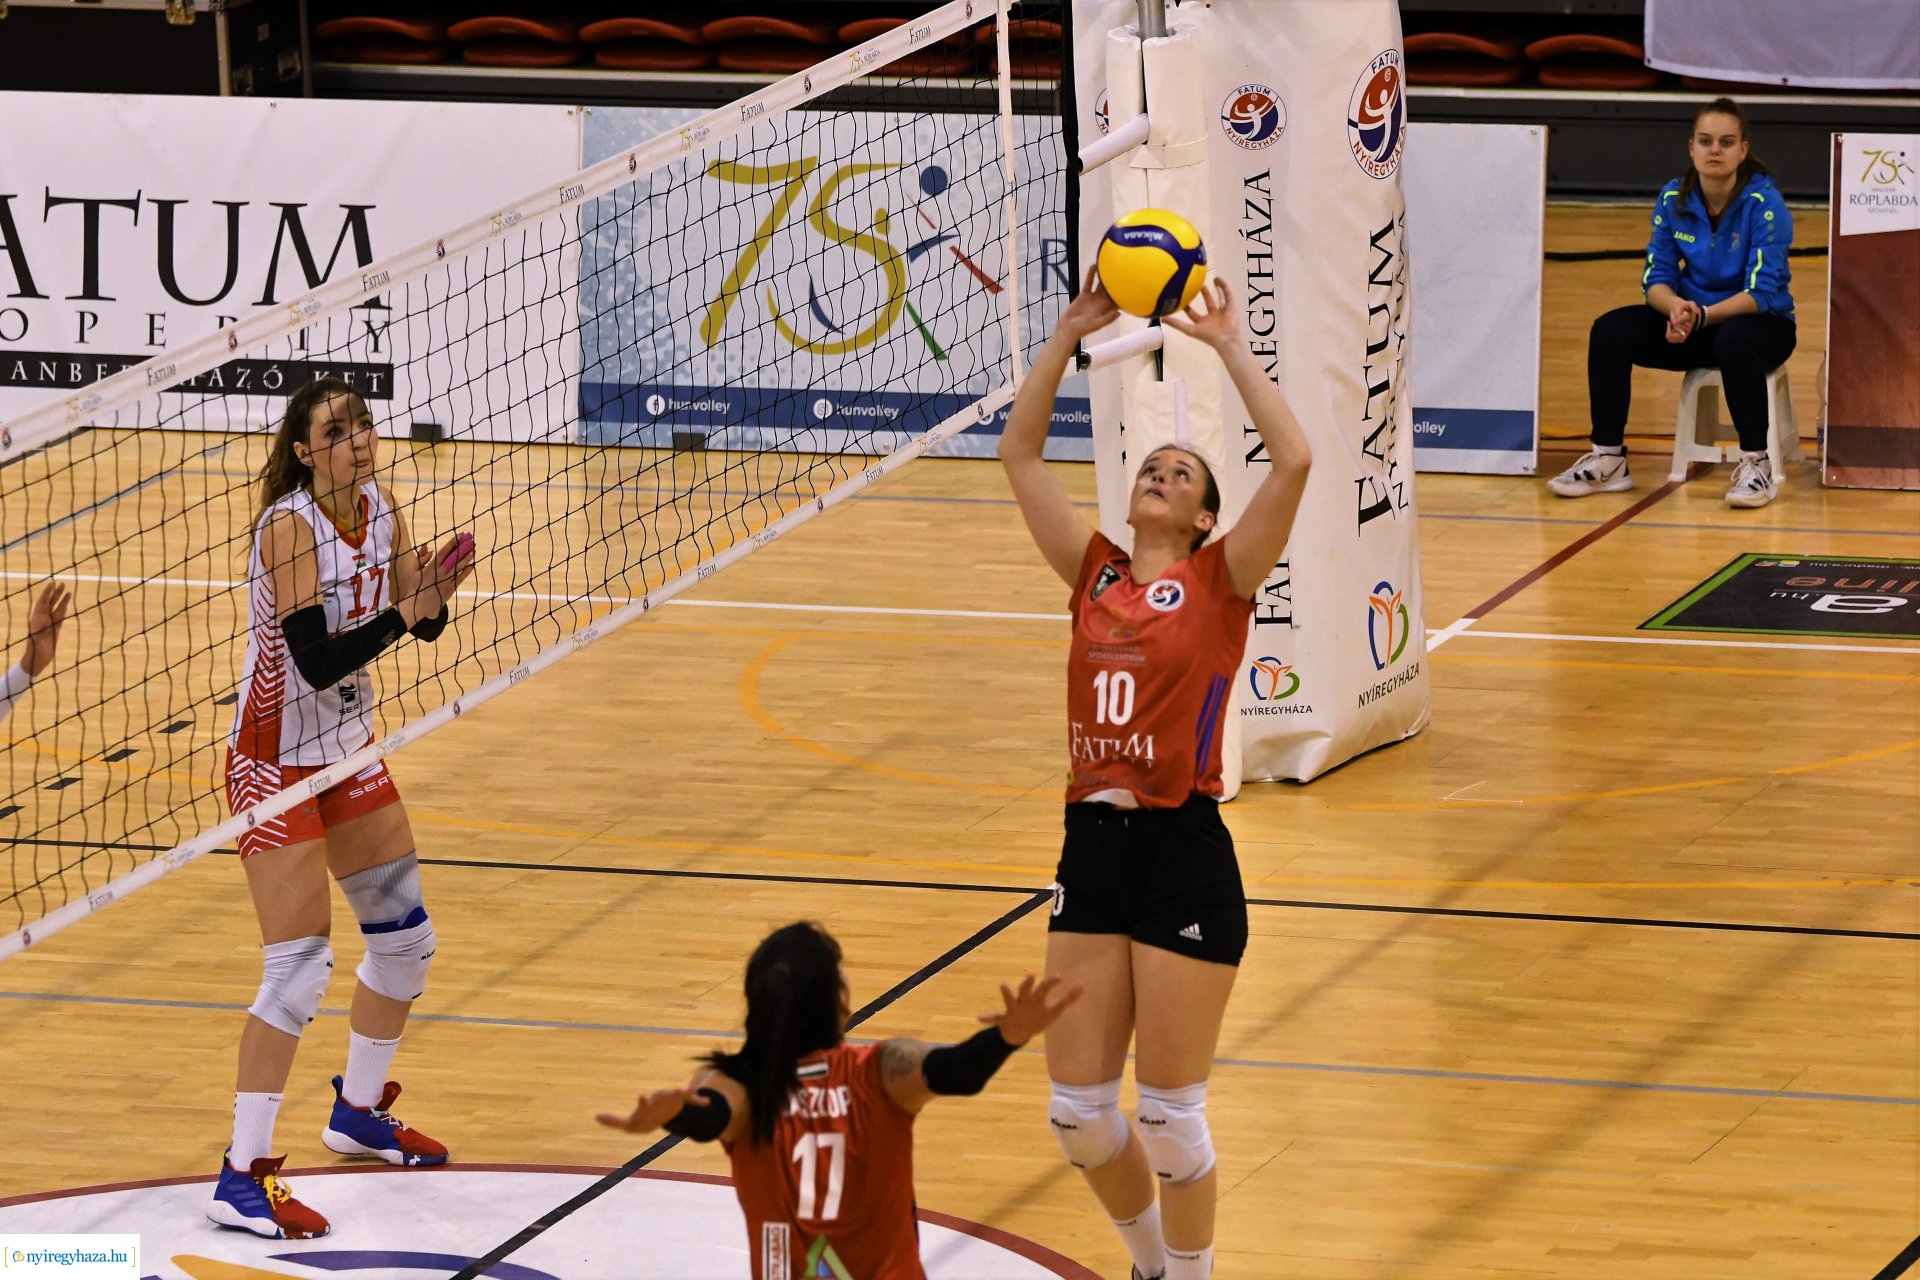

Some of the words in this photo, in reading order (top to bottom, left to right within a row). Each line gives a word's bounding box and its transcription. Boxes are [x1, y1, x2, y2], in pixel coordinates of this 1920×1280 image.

[909, 25, 931, 45] FATUM
[1237, 85, 1271, 96] FATUM
[740, 101, 764, 123] FATUM
[559, 183, 585, 204] FATUM
[1849, 192, 1919, 206] RÖPLABDA
[1674, 231, 1696, 244] JAKO
[362, 270, 391, 292] FATUM
[147, 363, 177, 388] FATUM
[1354, 211, 1396, 538] FATUM
[668, 398, 731, 415] hunvolley
[836, 403, 899, 419] hunvolley
[1413, 421, 1446, 437] olley
[865, 466, 884, 485] FATUM
[697, 563, 717, 582] FATUM
[346, 566, 386, 621] 17
[509, 666, 530, 686] FATUM
[1358, 662, 1420, 709] NYÍREGYHÁZA
[1093, 670, 1136, 726] 10
[1240, 704, 1313, 716] NYÍREGYHÁZA
[308, 774, 332, 795] FATUM
[349, 774, 390, 798] SEA
[792, 1132, 846, 1221] 17
